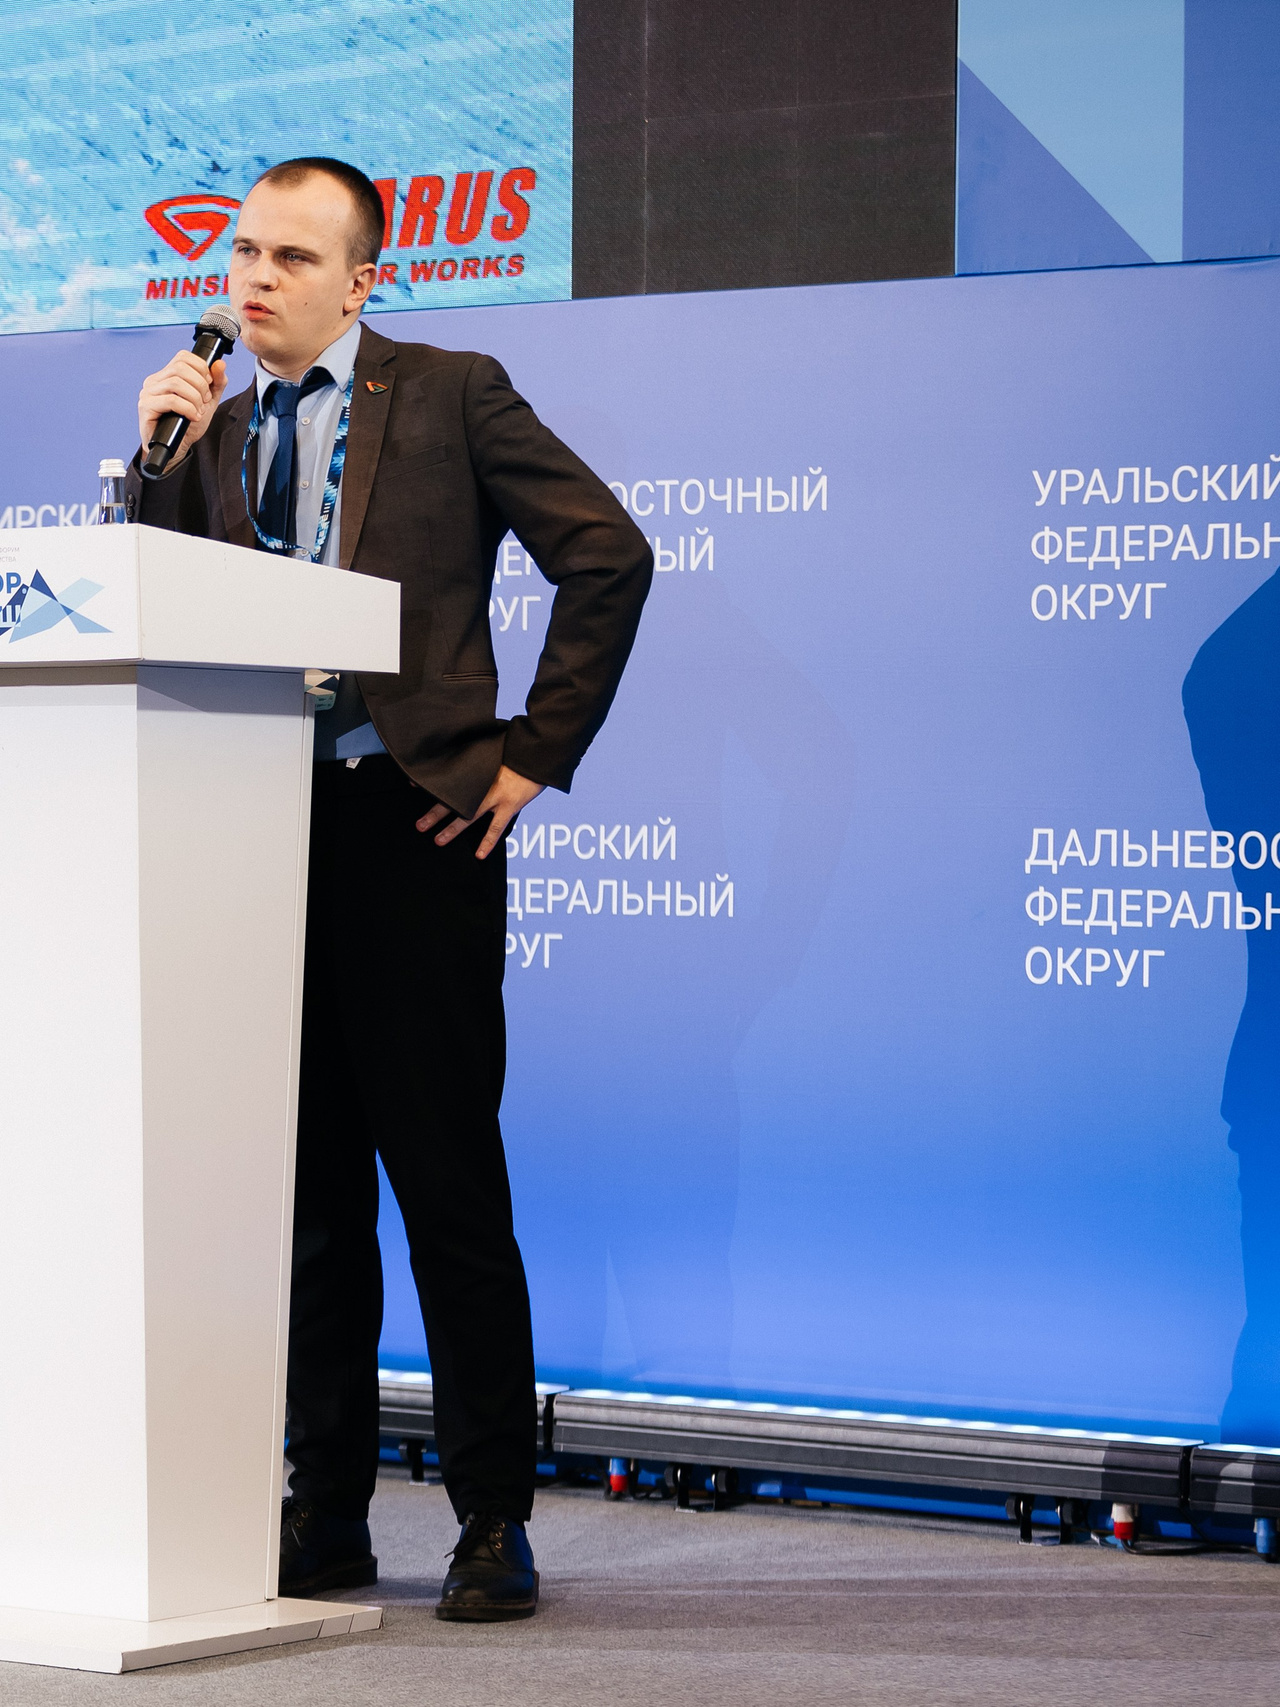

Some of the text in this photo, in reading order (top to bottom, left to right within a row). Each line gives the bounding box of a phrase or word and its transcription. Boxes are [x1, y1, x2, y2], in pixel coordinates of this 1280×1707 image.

[410, 254, 525, 283] WORKS
[607, 466, 829, 517] ОСТОЧНЫЙ
[1031, 454, 1280, 506] УРАЛЬСКИЙ
[1030, 522, 1280, 570] ФЕДЕРАЛЬН
[1030, 582, 1167, 621] ОКРУГ
[506, 873, 734, 921] ДЕРАЛЬНЫЙ
[1024, 945, 1165, 988] ОКРУГ
